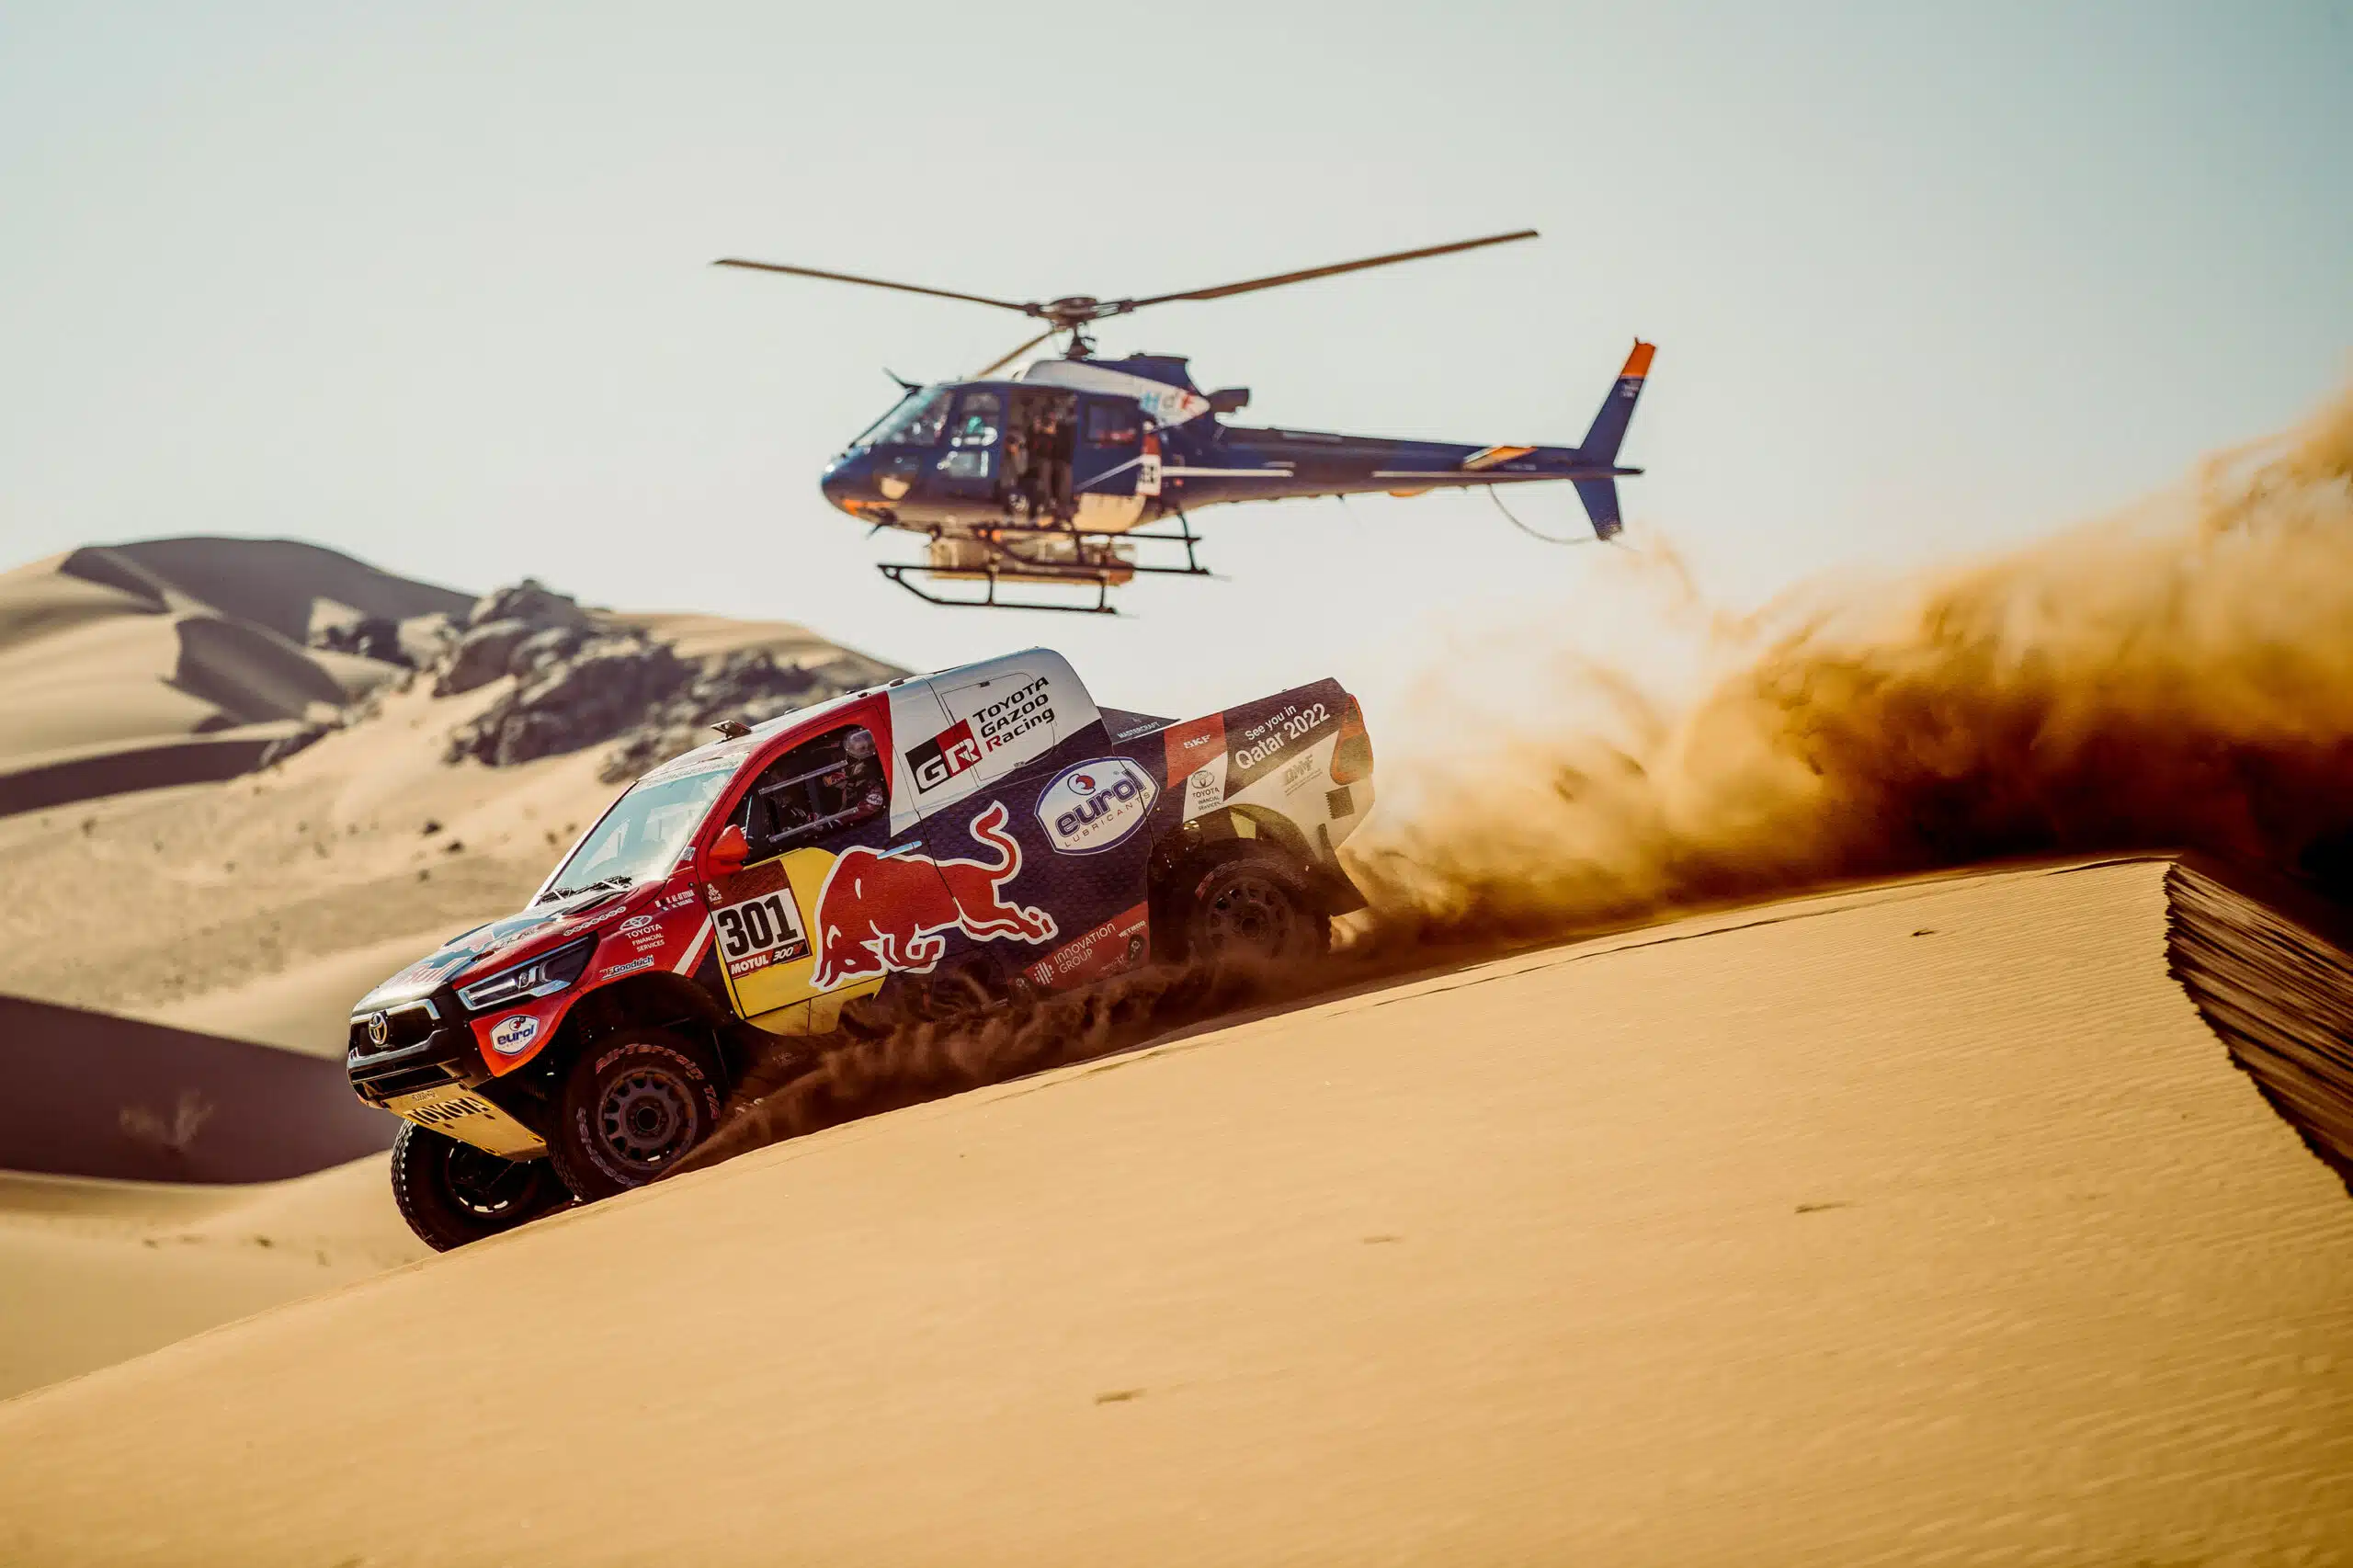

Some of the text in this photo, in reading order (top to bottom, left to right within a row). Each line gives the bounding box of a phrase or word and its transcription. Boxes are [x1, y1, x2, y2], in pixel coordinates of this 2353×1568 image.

[972, 676, 1050, 723] TOYOTA
[980, 694, 1049, 738] GAZOO
[985, 708, 1055, 753] Racing
[1117, 722, 1161, 739] MASTERCRAFT
[1245, 705, 1297, 741] See you in
[1184, 734, 1211, 749] SKF
[1234, 732, 1285, 769] Qatar
[1283, 703, 1331, 740] 2022
[915, 738, 980, 790] GR
[1055, 768, 1146, 837] eurol
[1192, 787, 1220, 799] TOYOTA
[1064, 792, 1151, 847] LUBRICANTS
[626, 923, 663, 939] TOYOTA
[631, 932, 664, 947] FINANCIAL
[717, 894, 798, 957] 301
[636, 938, 665, 952] SERVICES
[1053, 922, 1116, 965] INNOVATION
[731, 954, 768, 974] MOTUL
[1059, 948, 1093, 974] GROUP
[497, 1024, 534, 1046] eurol
[404, 1096, 493, 1125] TOYOTA
